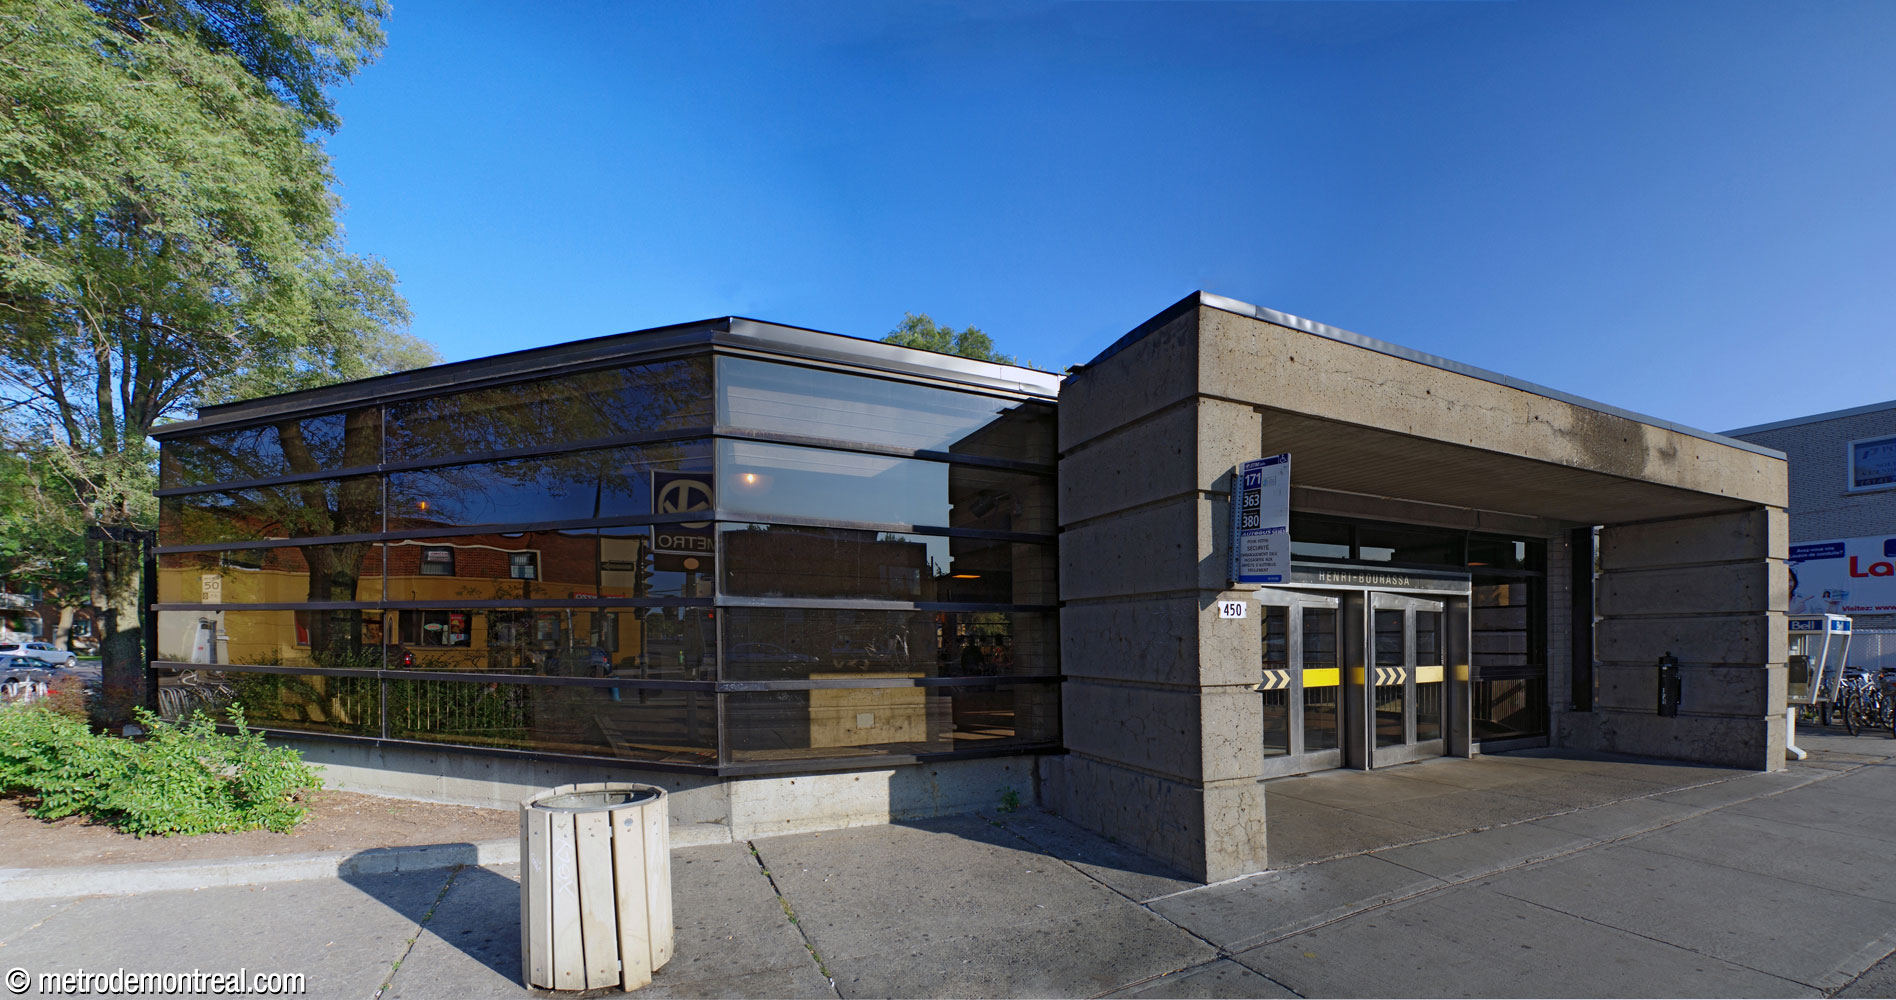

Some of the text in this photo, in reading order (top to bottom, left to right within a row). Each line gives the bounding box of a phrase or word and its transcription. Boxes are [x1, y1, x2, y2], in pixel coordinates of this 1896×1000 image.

[1245, 473, 1261, 486] 171
[1243, 494, 1260, 507] 363
[1242, 515, 1259, 528] 380
[1318, 570, 1410, 586] HENRI-BOURASSA
[204, 581, 220, 590] 50
[1223, 603, 1242, 617] 450
[1791, 620, 1815, 630] Bell
